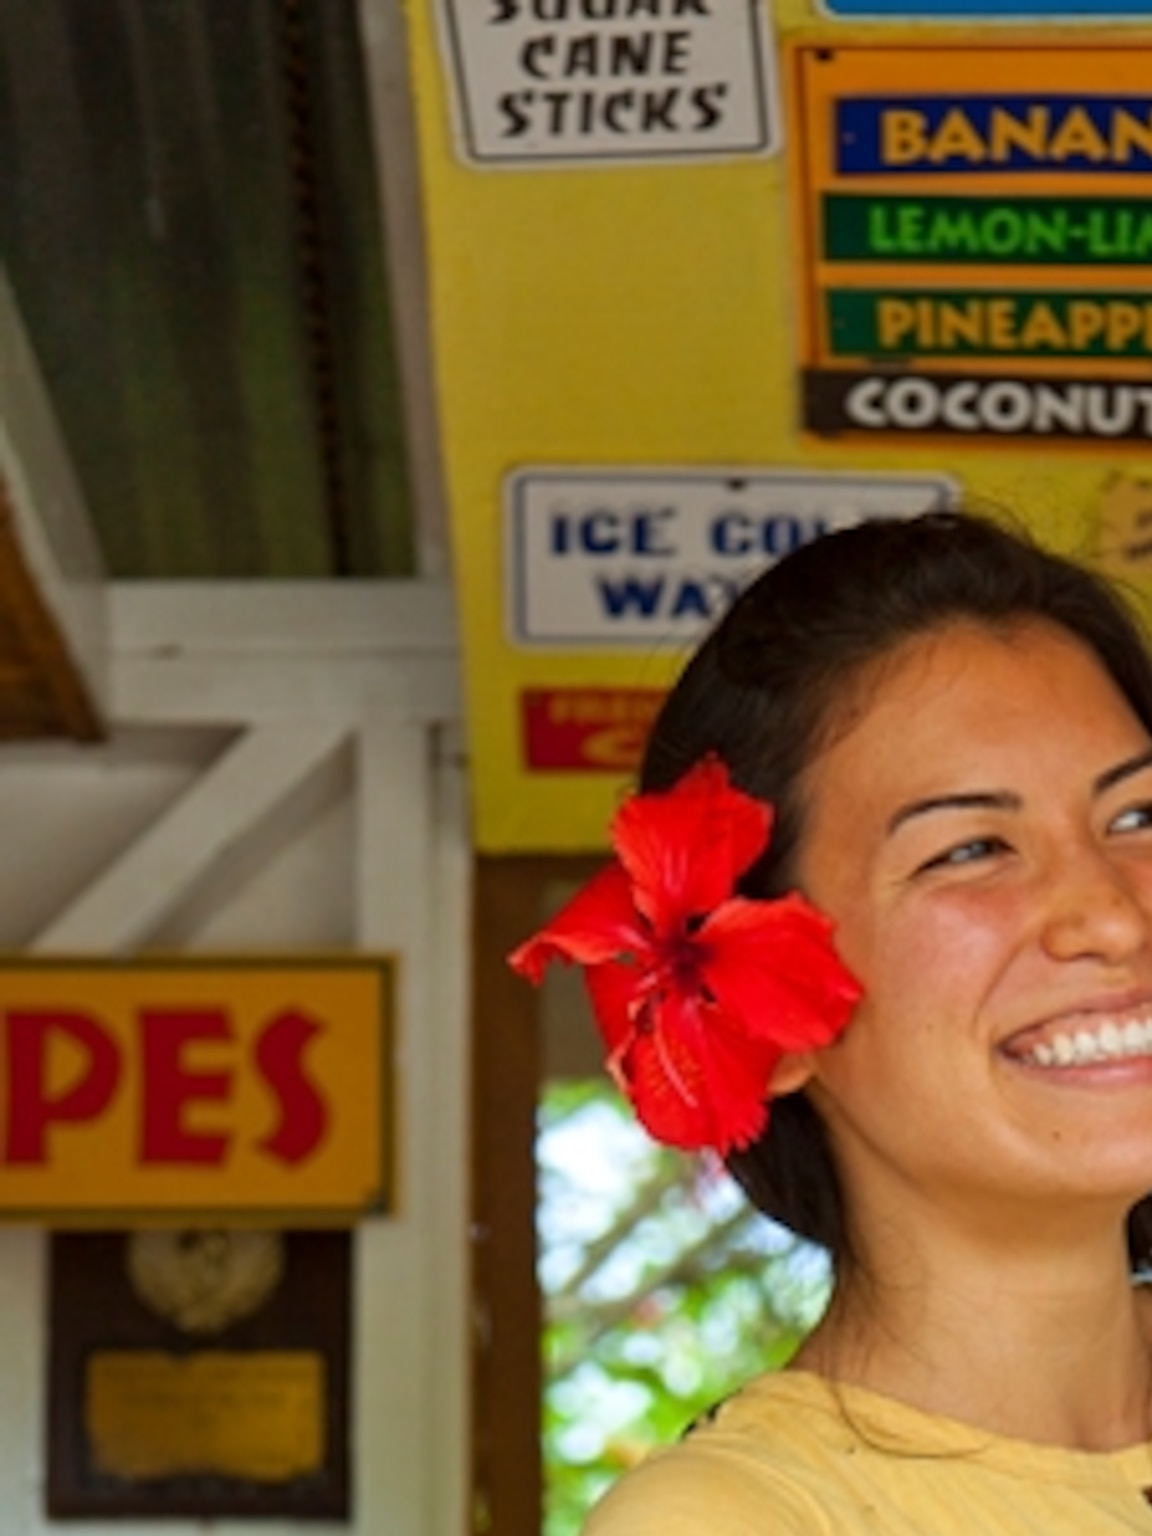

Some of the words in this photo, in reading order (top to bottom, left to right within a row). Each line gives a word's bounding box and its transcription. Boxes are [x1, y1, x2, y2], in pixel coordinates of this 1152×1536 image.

[519, 30, 692, 79] CANE
[496, 82, 730, 138] STICKS
[549, 507, 676, 559] ICE
[3, 1003, 333, 1172] PES
